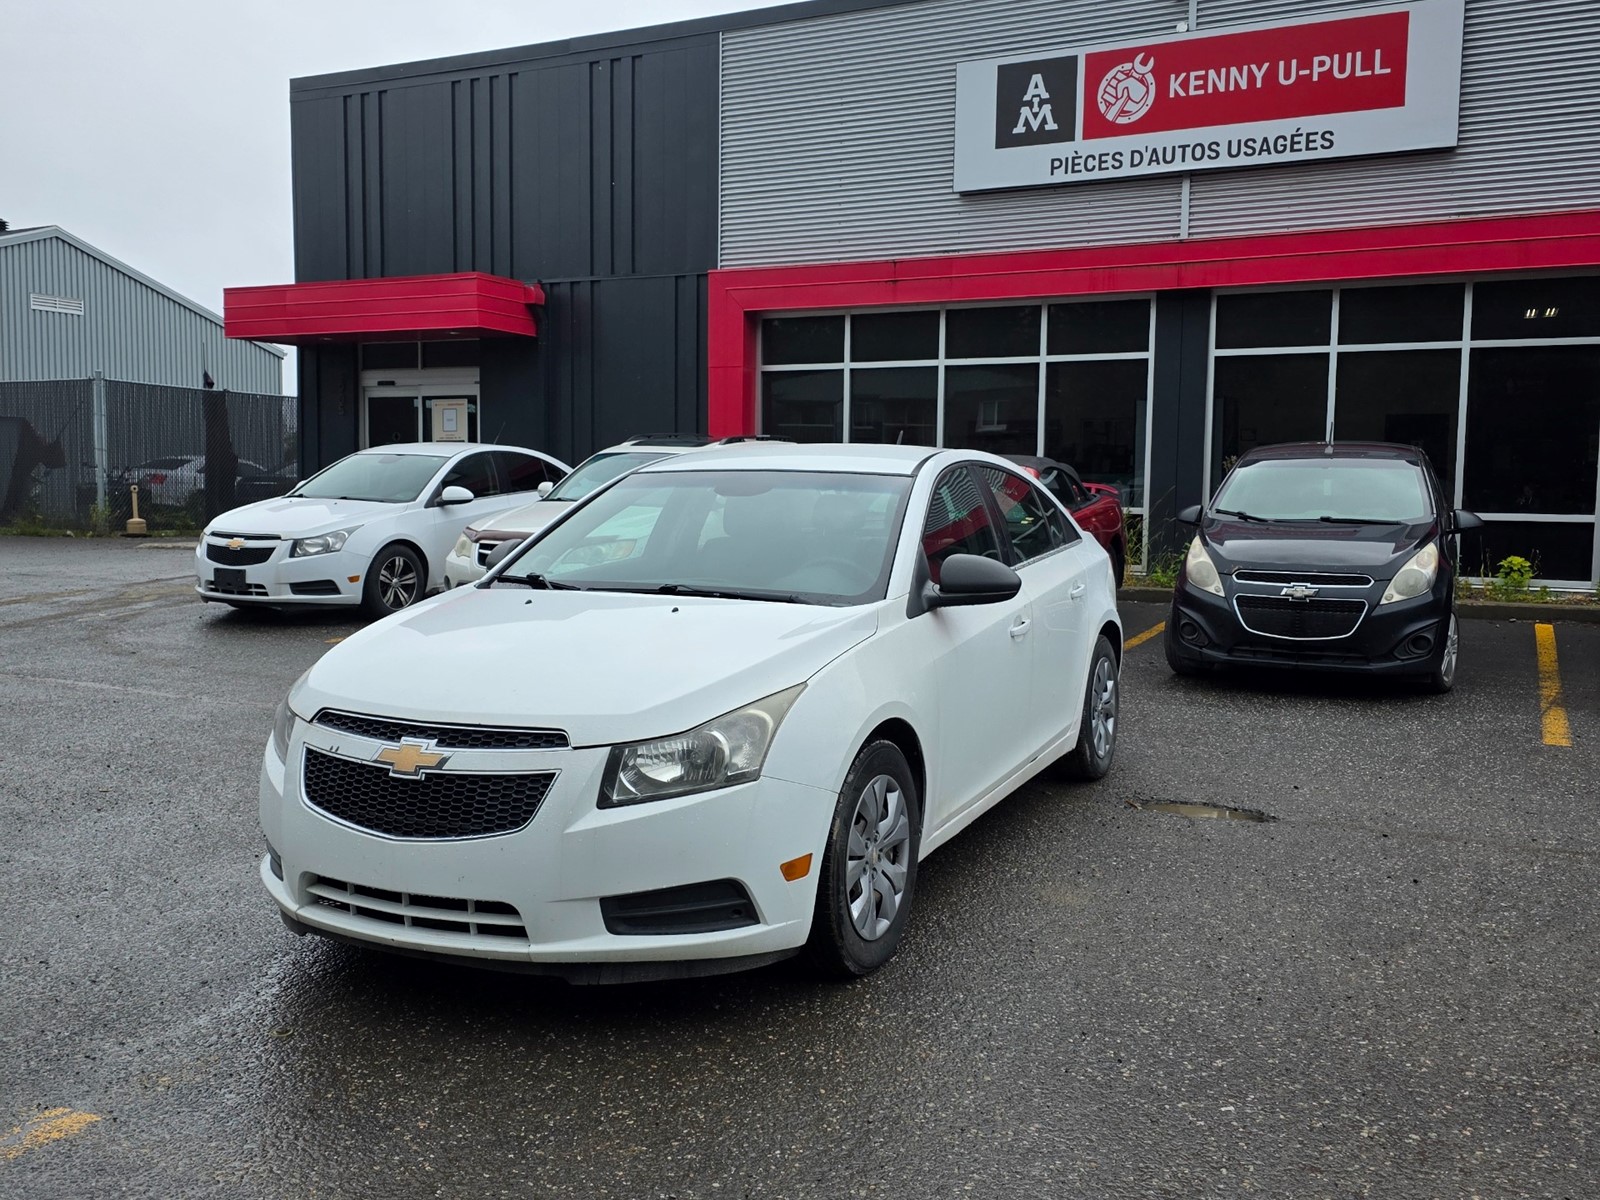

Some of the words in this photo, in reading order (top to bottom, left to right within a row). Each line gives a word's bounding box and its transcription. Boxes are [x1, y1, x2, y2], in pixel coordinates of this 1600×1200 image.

[1169, 62, 1270, 98] KENNY
[1278, 49, 1391, 86] U-PULL
[1050, 150, 1123, 176] PIÈCES
[1129, 141, 1221, 168] D'AUTOS
[1227, 127, 1335, 158] USAGÉES
